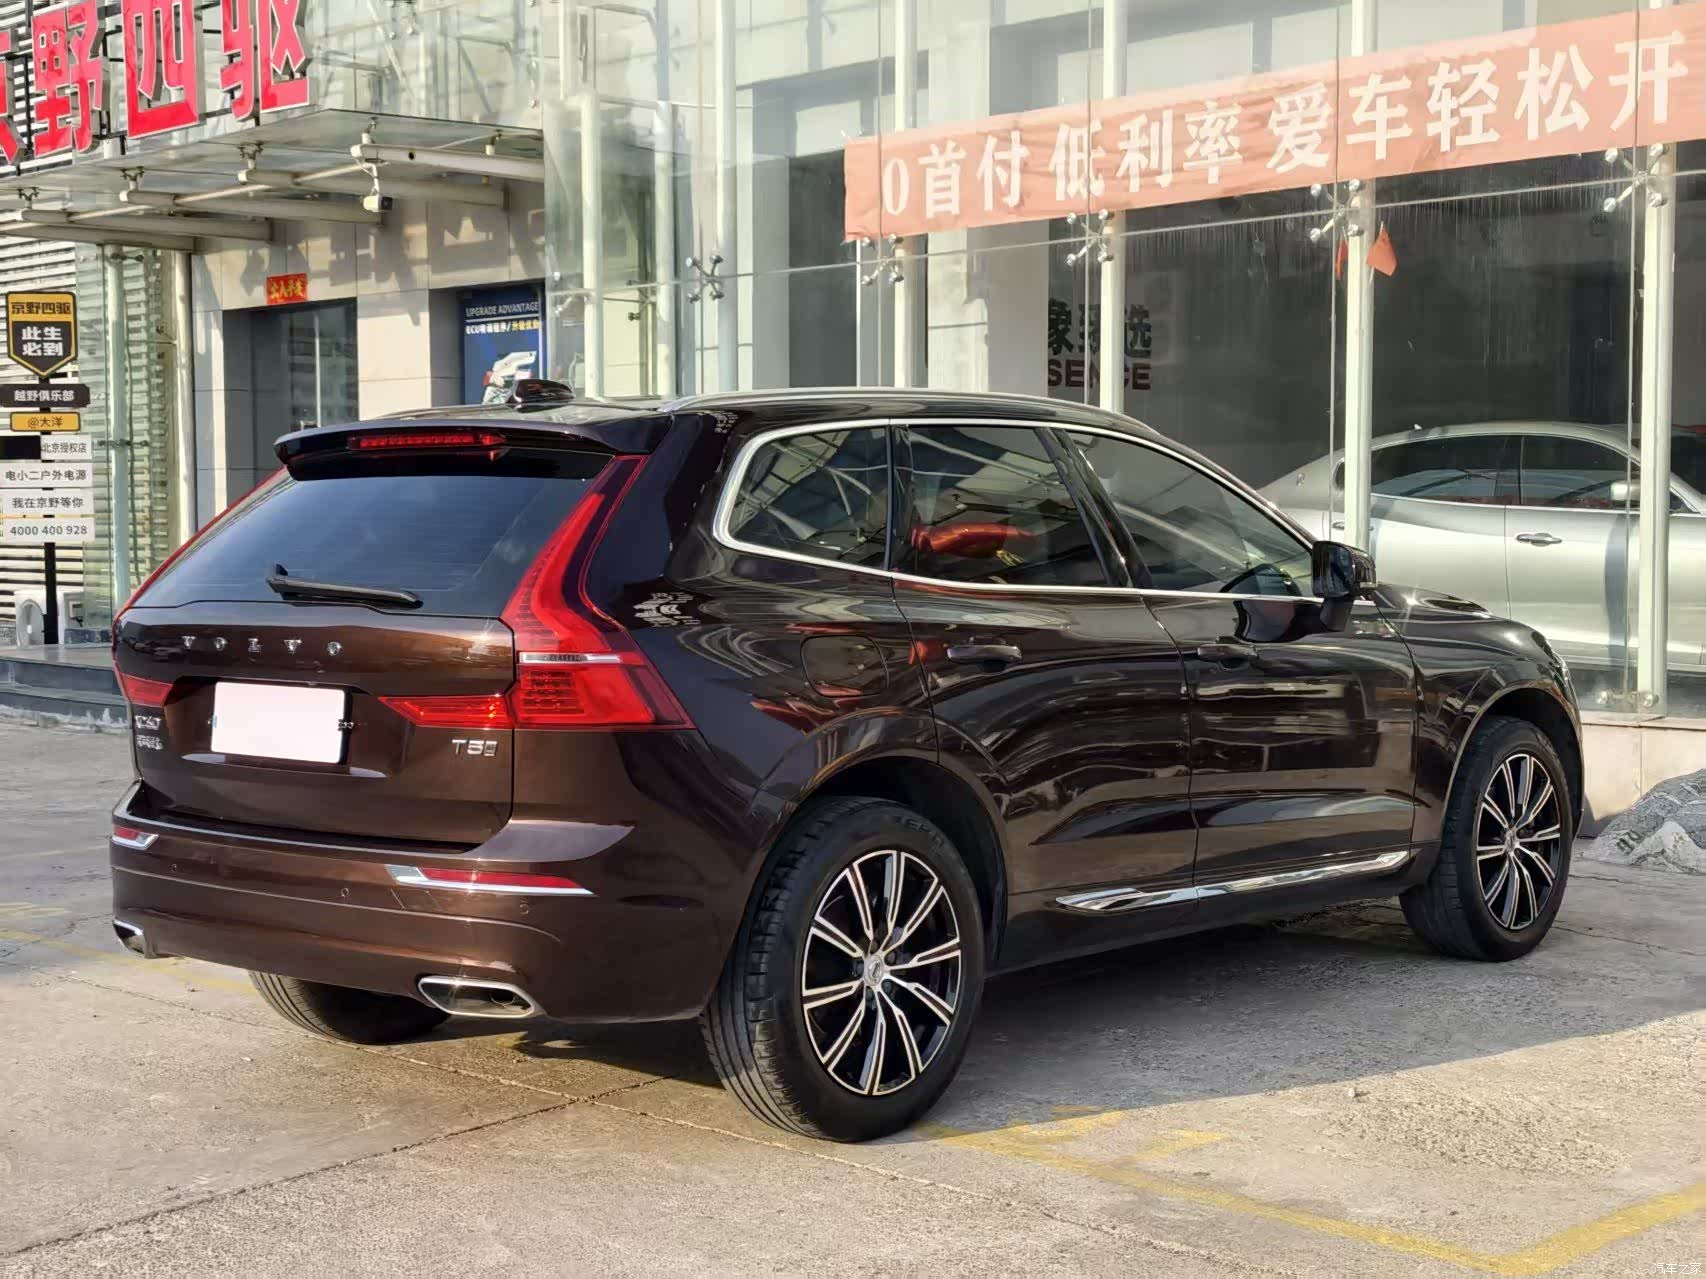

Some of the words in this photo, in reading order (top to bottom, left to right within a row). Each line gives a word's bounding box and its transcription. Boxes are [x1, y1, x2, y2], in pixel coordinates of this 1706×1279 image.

[11, 302, 72, 314] 京野四驱
[465, 305, 497, 317] UPGRADE
[498, 301, 539, 314] ADVANTAGE
[21, 326, 63, 341] 此生
[22, 342, 64, 357] 必到
[14, 390, 75, 402] 越野俱乐部
[28, 416, 64, 428] @大洋
[41, 442, 87, 454] 北京授权店
[5, 469, 87, 481] 电小二户外电源
[12, 497, 84, 509] 我在京野等你
[10, 526, 39, 536] 4000
[42, 525, 63, 536] 400
[66, 525, 88, 535] 928
[181, 635, 343, 657] VOLVO
